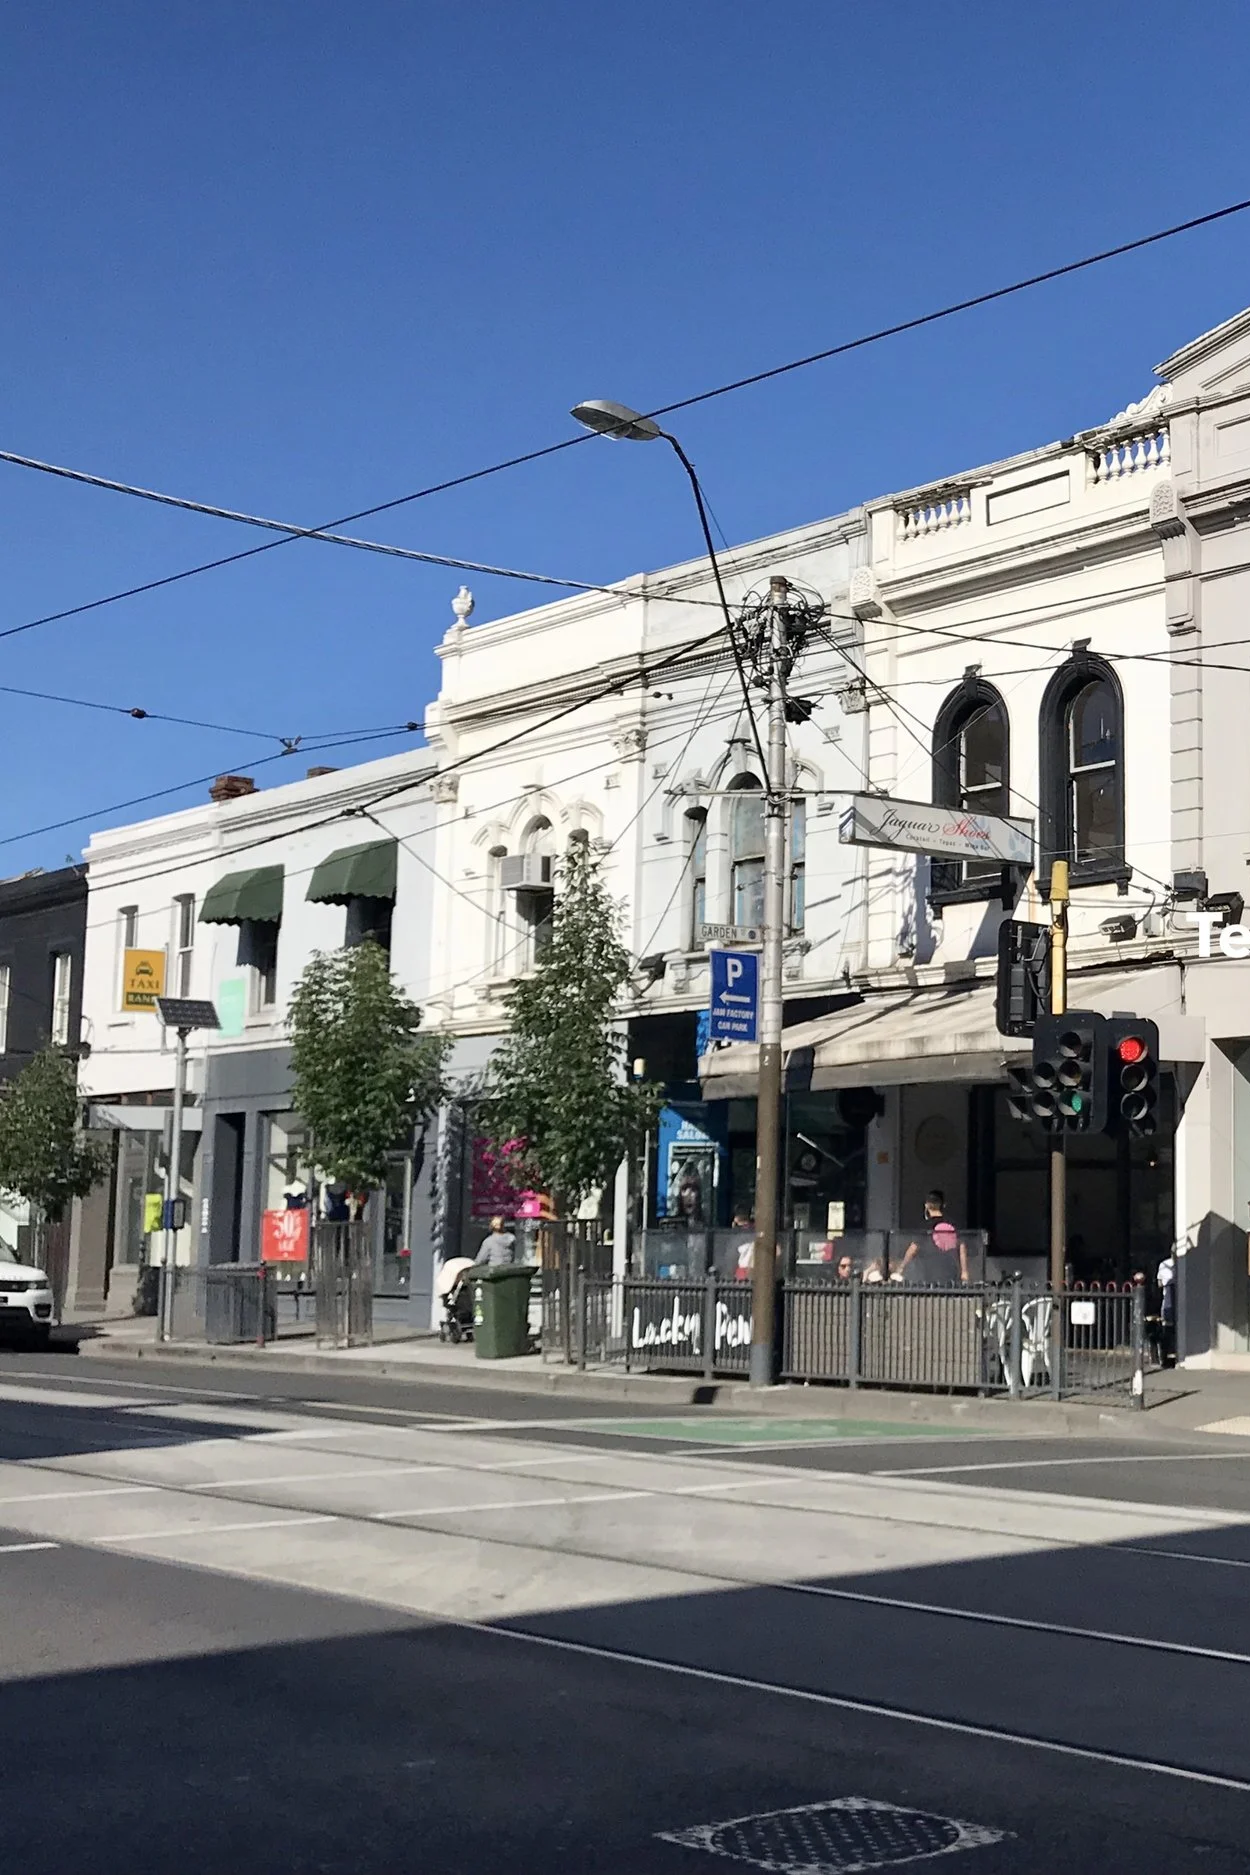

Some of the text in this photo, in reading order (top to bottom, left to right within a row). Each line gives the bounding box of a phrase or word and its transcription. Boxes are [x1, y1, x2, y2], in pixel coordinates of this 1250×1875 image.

[869, 808, 941, 843] Jaguar
[701, 925, 738, 939] GARDEN
[726, 958, 743, 988] P
[129, 978, 160, 989] TAXI
[727, 1009, 754, 1020] FACTORY
[731, 1022, 748, 1033] PARK
[632, 1295, 701, 1355] Lucky
